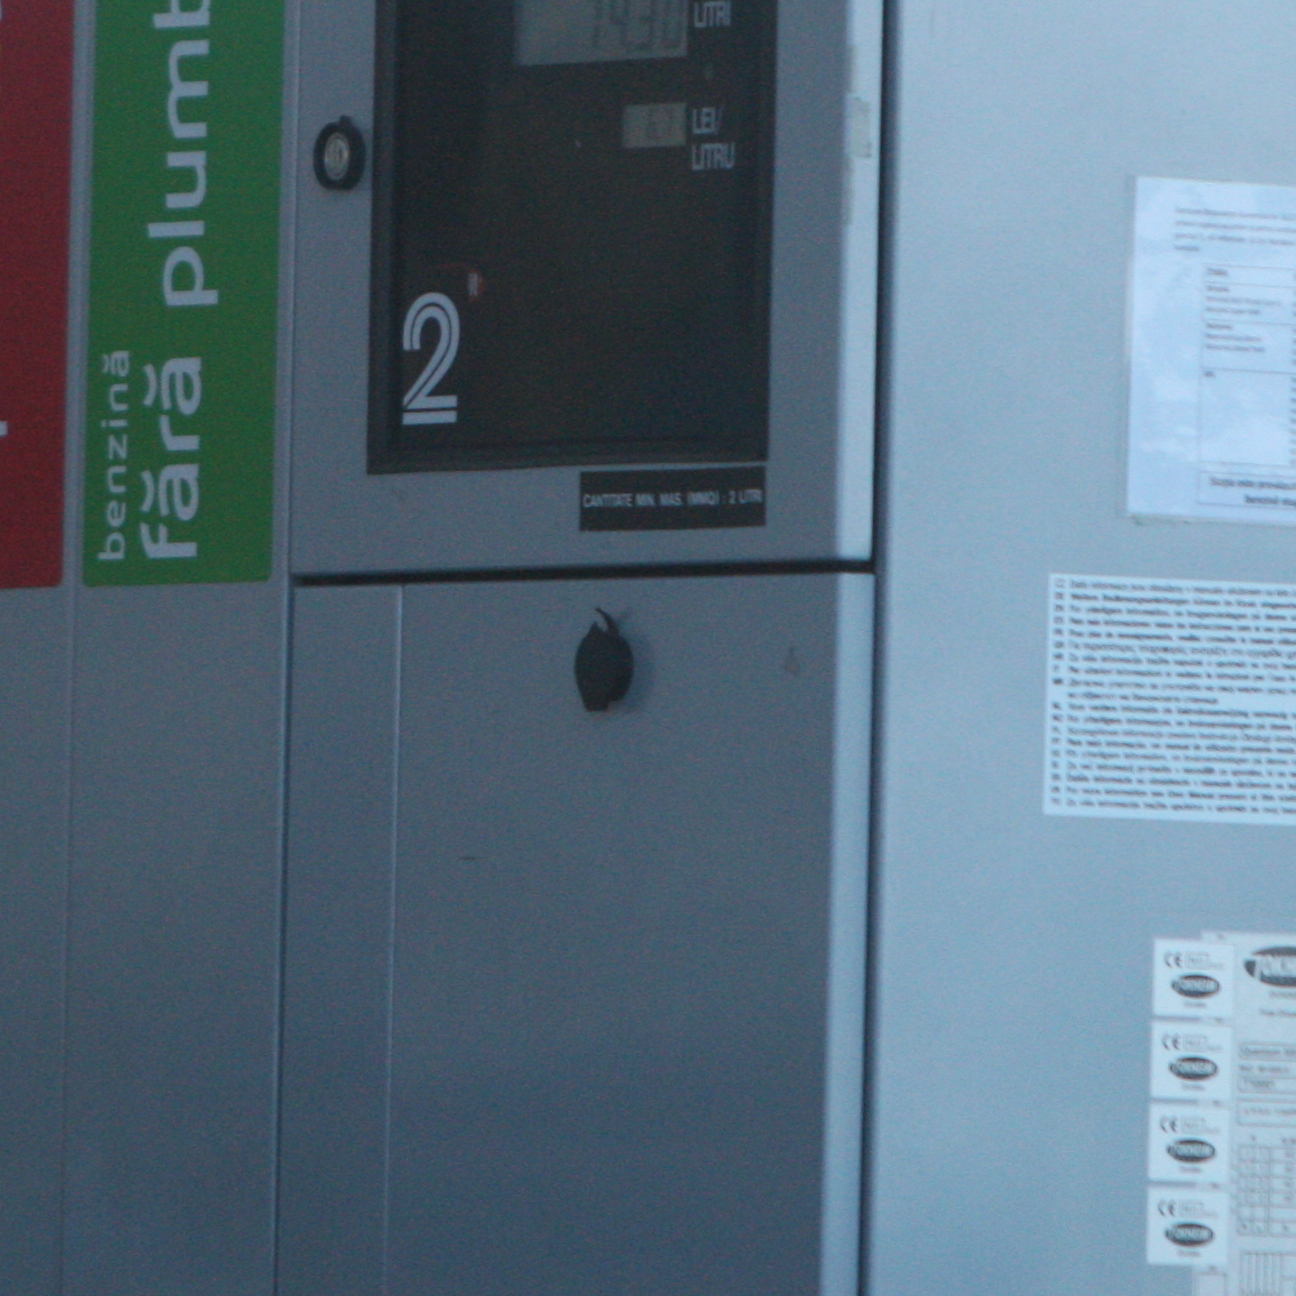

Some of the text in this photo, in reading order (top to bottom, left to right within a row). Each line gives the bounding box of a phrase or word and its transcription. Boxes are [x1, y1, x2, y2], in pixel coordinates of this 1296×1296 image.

[693, 0, 732, 29] LITRI
[691, 142, 736, 171] LITRU
[400, 290, 462, 426] 2
[97, 349, 131, 562] benzină
[138, 355, 203, 560] fără
